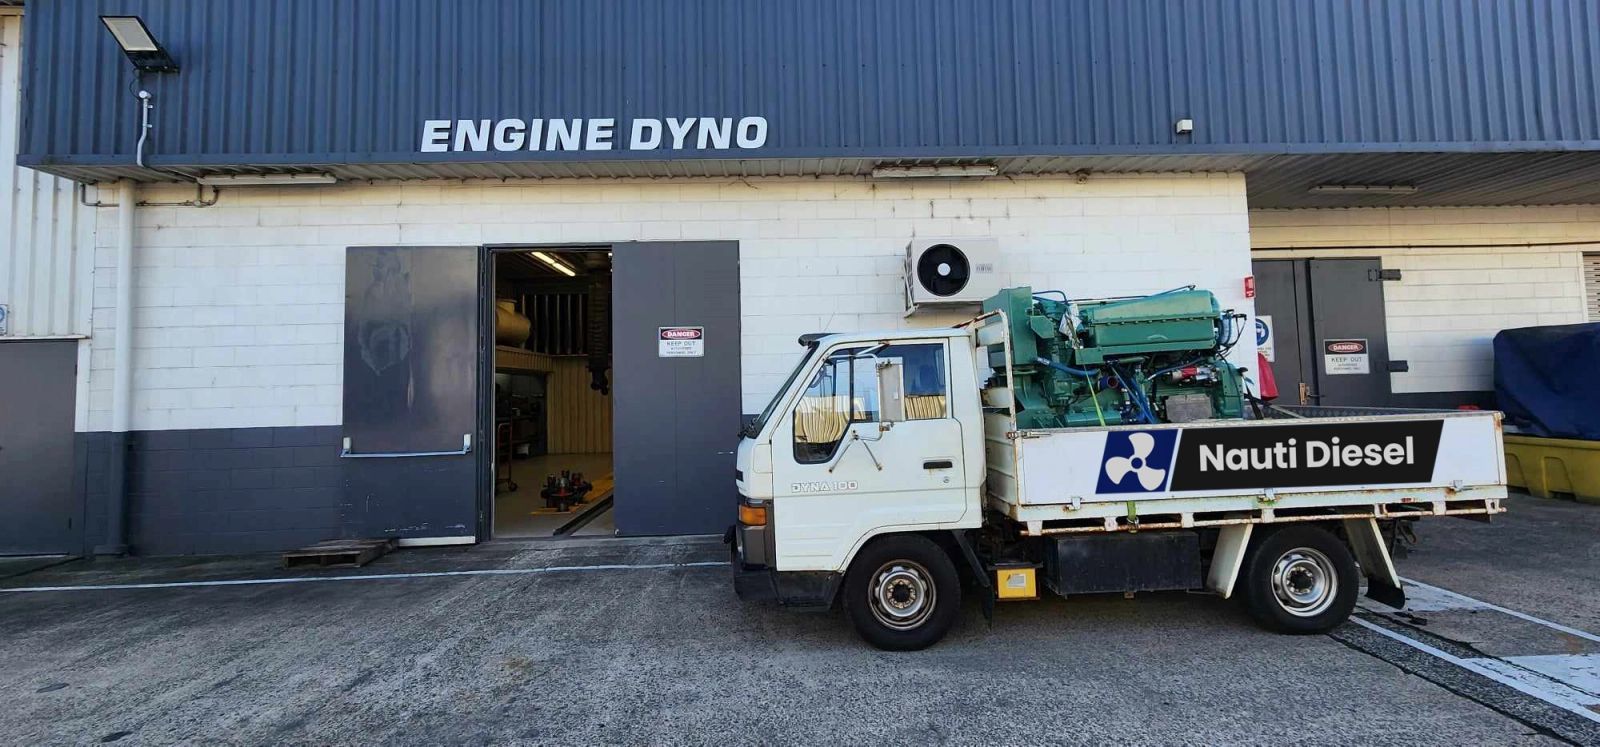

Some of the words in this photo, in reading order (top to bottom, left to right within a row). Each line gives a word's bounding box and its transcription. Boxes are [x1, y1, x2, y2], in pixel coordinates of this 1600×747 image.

[421, 118, 615, 153] ENGINE
[629, 117, 768, 151] DYNO
[1199, 437, 1297, 472] Nauti
[1306, 435, 1415, 469] Diesel
[791, 481, 831, 493] DYNA
[833, 480, 858, 491] 100
